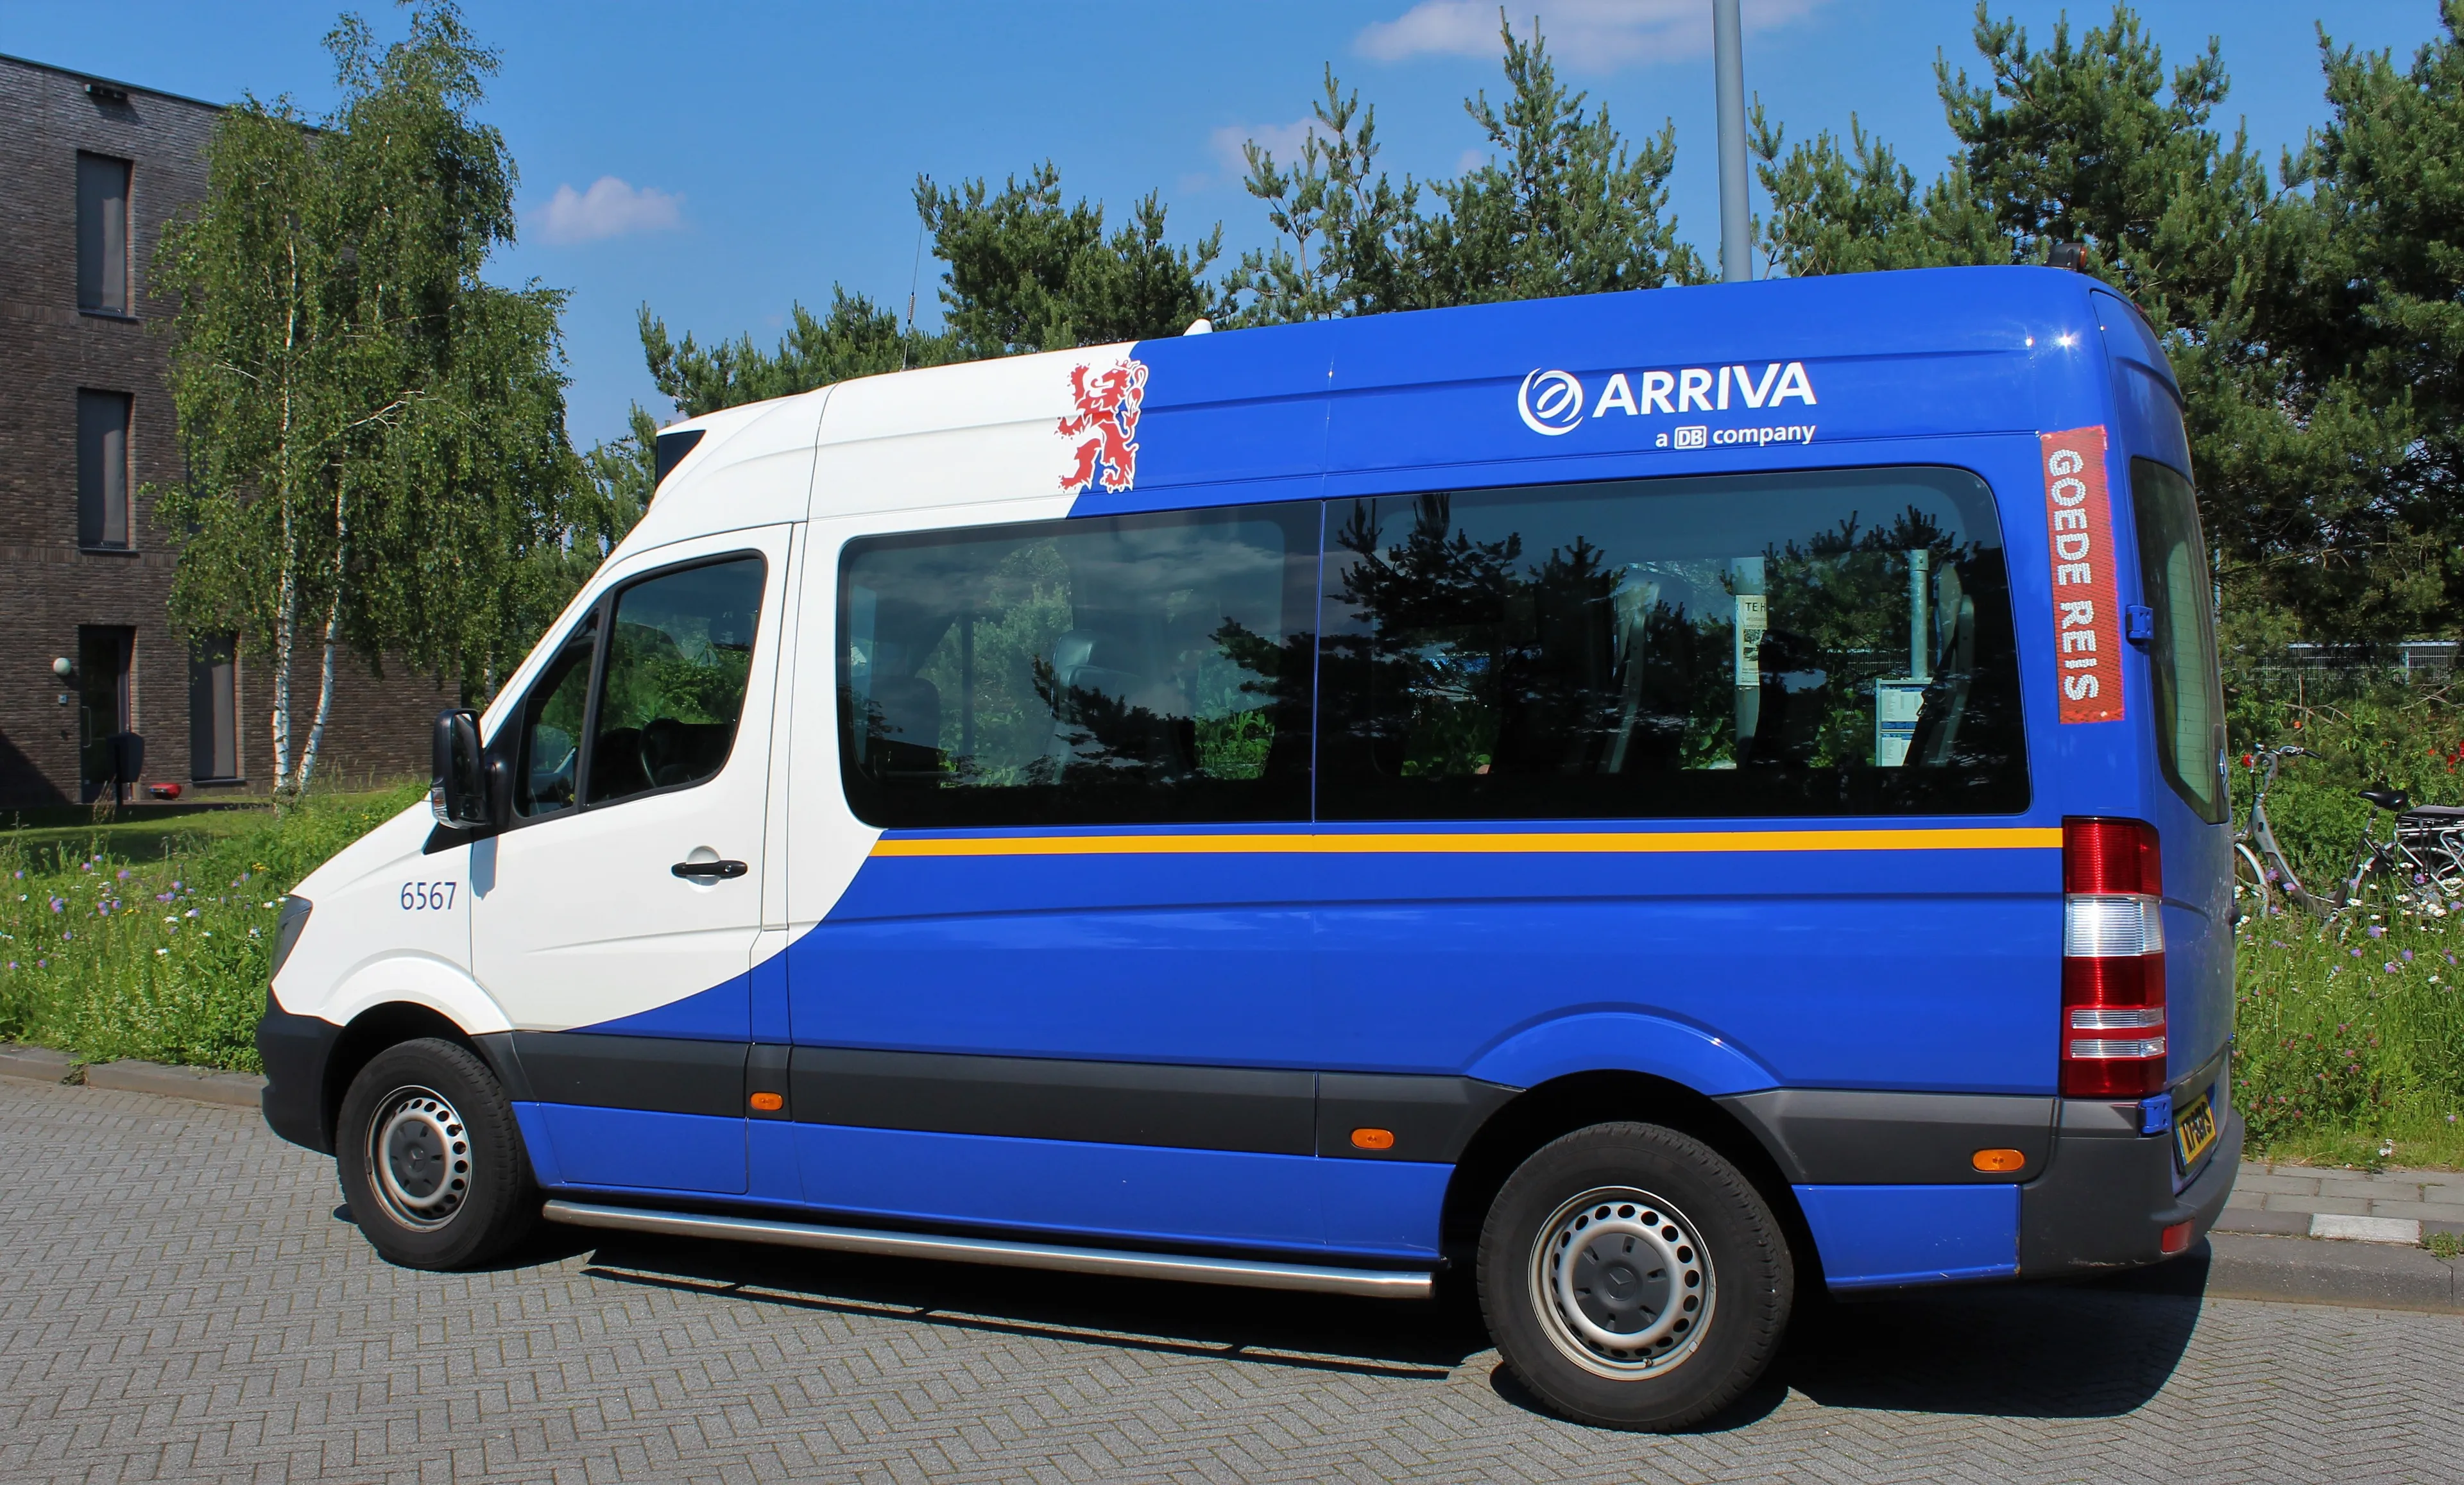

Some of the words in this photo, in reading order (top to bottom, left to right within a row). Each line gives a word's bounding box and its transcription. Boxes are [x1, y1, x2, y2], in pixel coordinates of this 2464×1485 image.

[1592, 362, 1817, 418] ARRIVA
[1655, 432, 1668, 447] a
[1676, 429, 1704, 448] DB
[1713, 425, 1816, 446] company
[2048, 449, 2092, 586] GOEDE
[1745, 602, 1758, 612] TE
[2059, 600, 2100, 701] REIS
[400, 881, 458, 910] 6567
